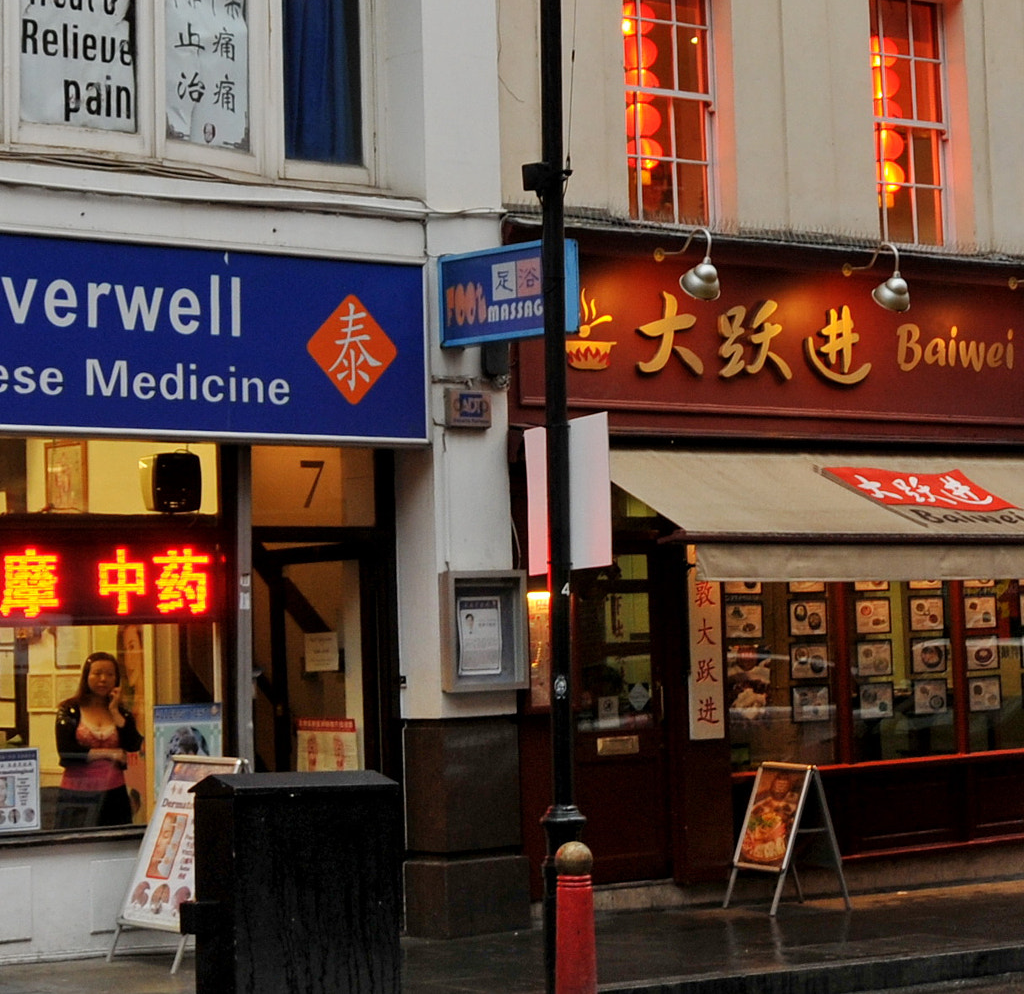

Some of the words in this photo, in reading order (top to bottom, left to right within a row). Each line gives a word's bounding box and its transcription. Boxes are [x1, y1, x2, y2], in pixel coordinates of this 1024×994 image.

[21, 17, 133, 67] Relieve
[174, 22, 236, 62] 止痛
[63, 77, 132, 122] pain
[177, 71, 236, 113] 治痛
[495, 267, 541, 293] 足浴
[487, 298, 544, 323] MASSAG
[328, 302, 382, 392] 泰
[637, 291, 871, 385] 大跃进
[897, 323, 1015, 372] Baiwei
[85, 358, 291, 405] Medicine
[300, 460, 325, 508] 7
[98, 548, 209, 615] 中药
